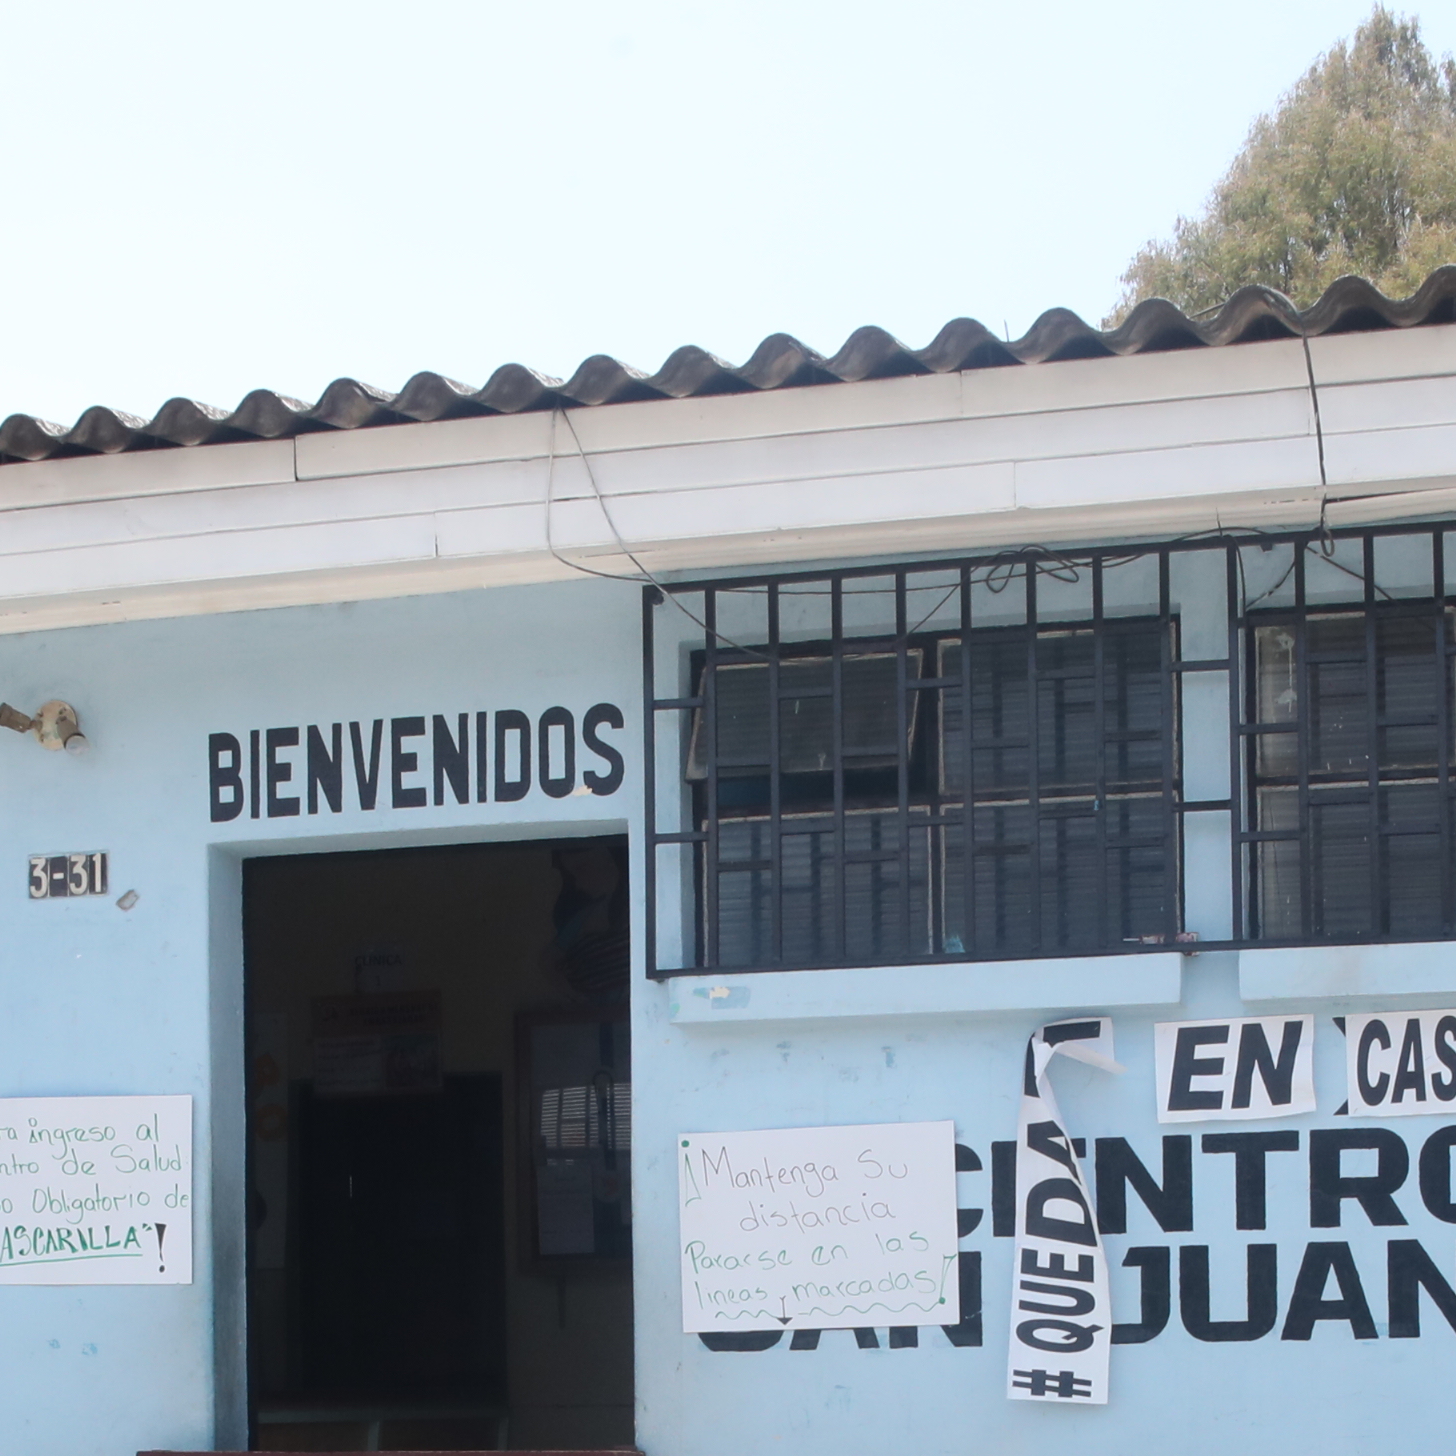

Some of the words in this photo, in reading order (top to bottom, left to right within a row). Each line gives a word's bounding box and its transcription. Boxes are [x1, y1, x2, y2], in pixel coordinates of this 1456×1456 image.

[208, 702, 625, 823] BIENVENIDOS
[29, 853, 104, 898] 3-31
[1167, 1020, 1303, 1112] EN
[28, 1117, 116, 1160] ingreso
[136, 1113, 159, 1142] al
[61, 1148, 96, 1176] de
[110, 1144, 182, 1173] Salud
[857, 1149, 908, 1179] Su
[32, 1183, 150, 1225] Obligatorio
[164, 1183, 189, 1209] de
[740, 1192, 896, 1233] distancia
[685, 1240, 792, 1274] Pararse
[811, 1245, 849, 1266] en
[875, 1231, 929, 1255] las
[694, 1281, 767, 1309] lineas
